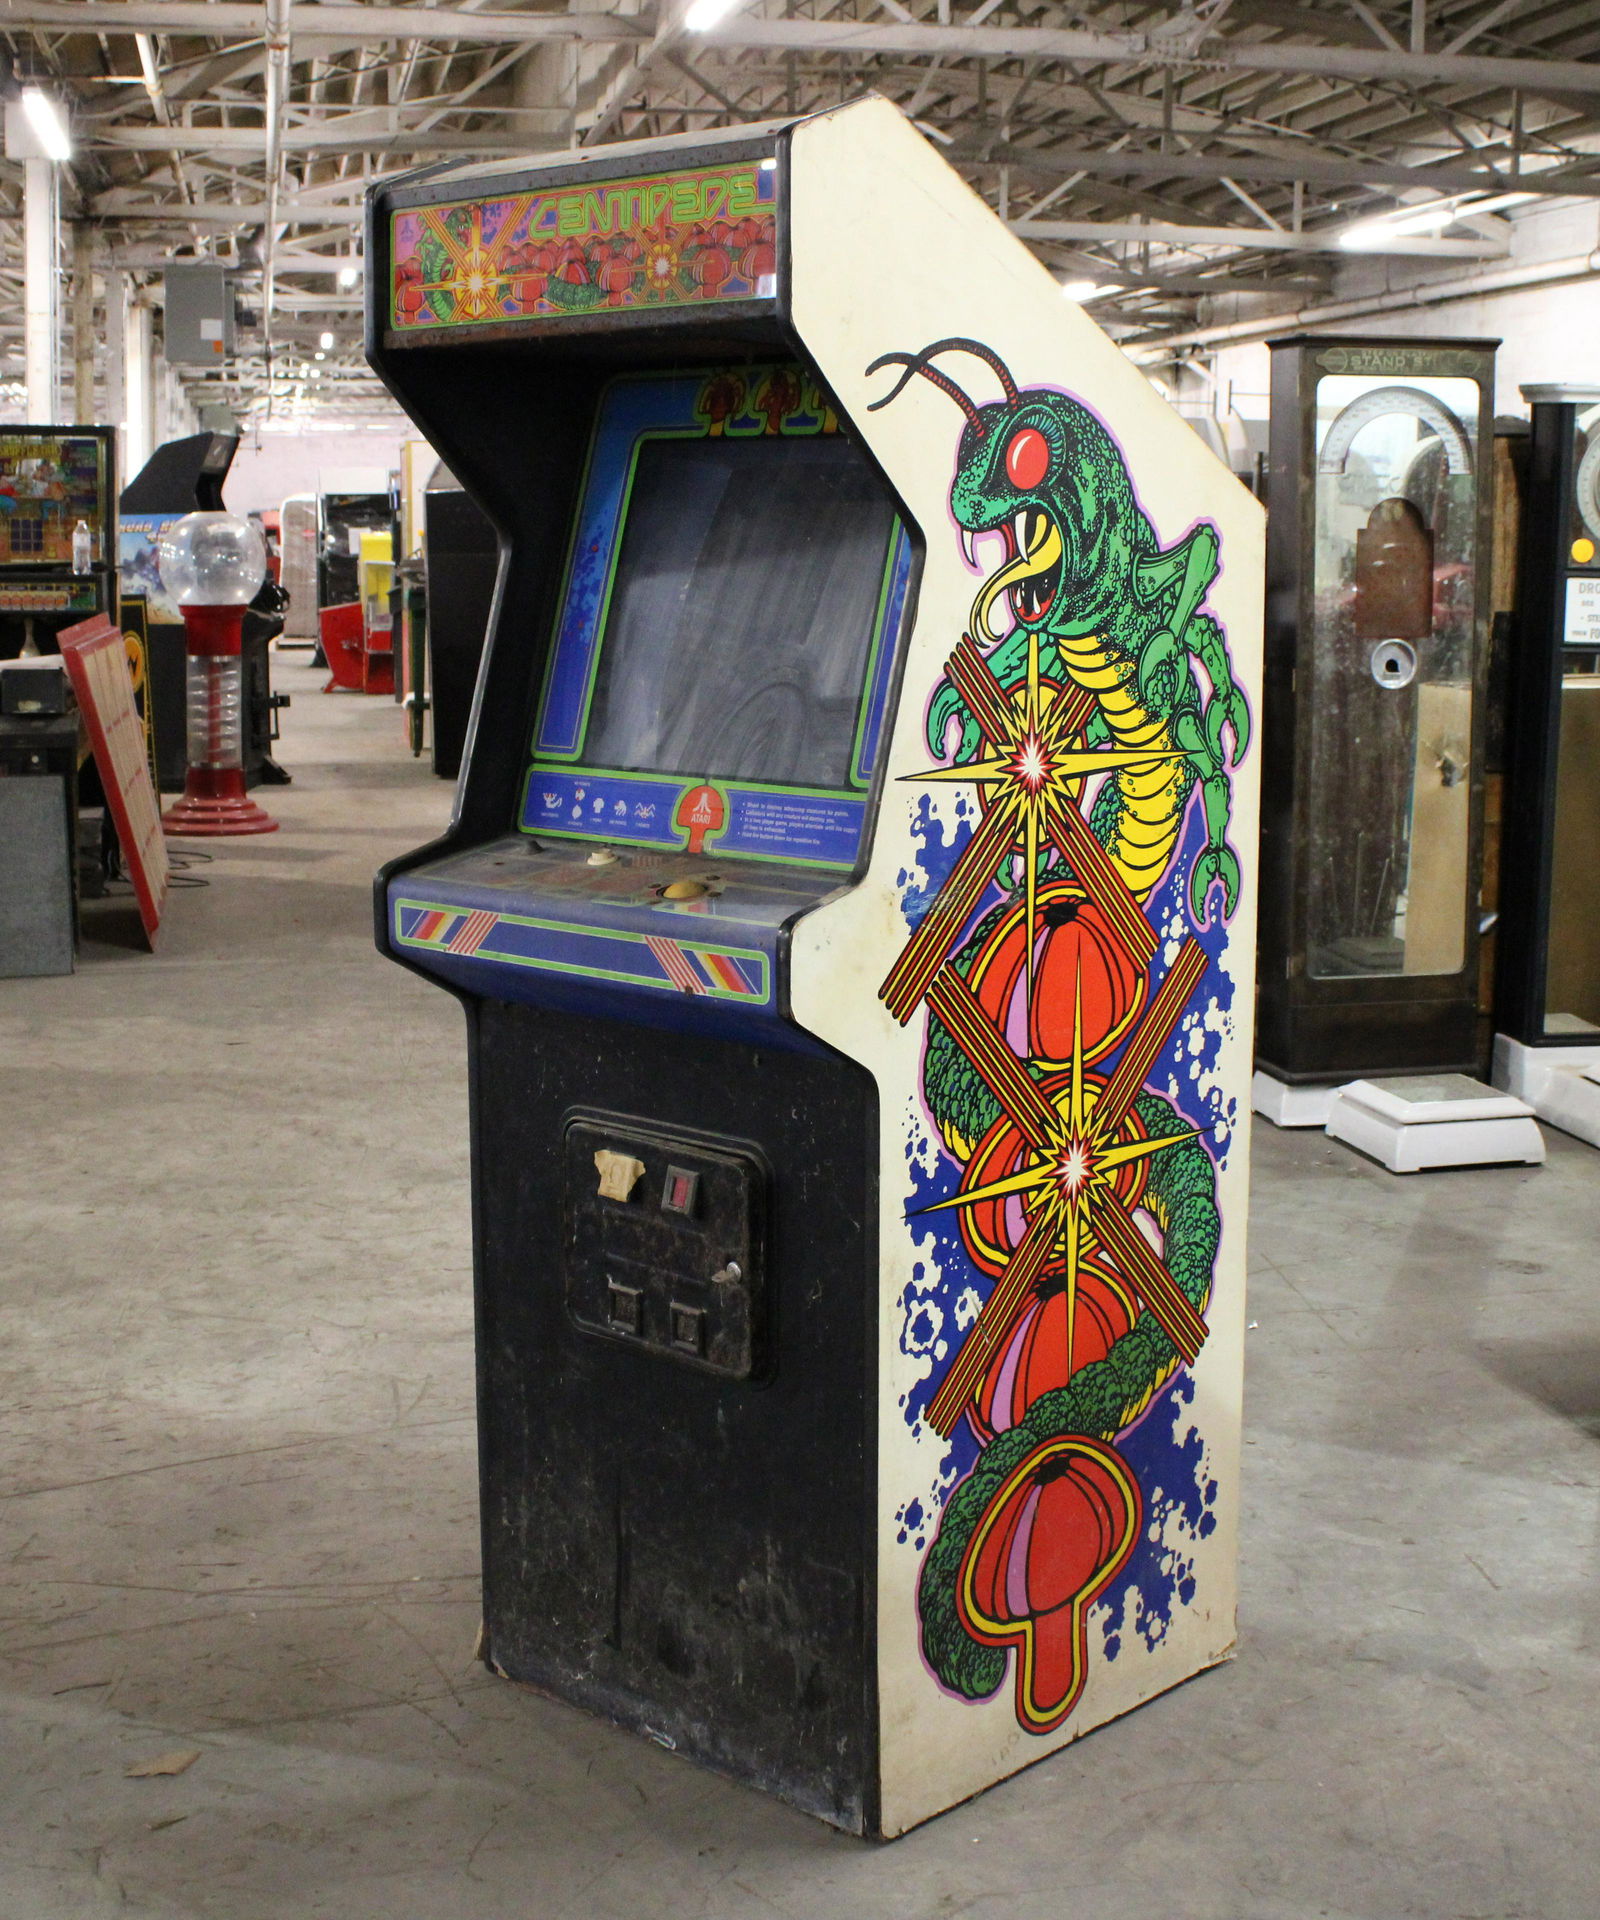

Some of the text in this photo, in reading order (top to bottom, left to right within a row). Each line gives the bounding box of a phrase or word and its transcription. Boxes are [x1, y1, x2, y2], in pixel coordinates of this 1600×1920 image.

[529, 172, 776, 240] CENTIPEDE
[1350, 356, 1406, 367] STAND
[690, 814, 711, 825] ATARI
